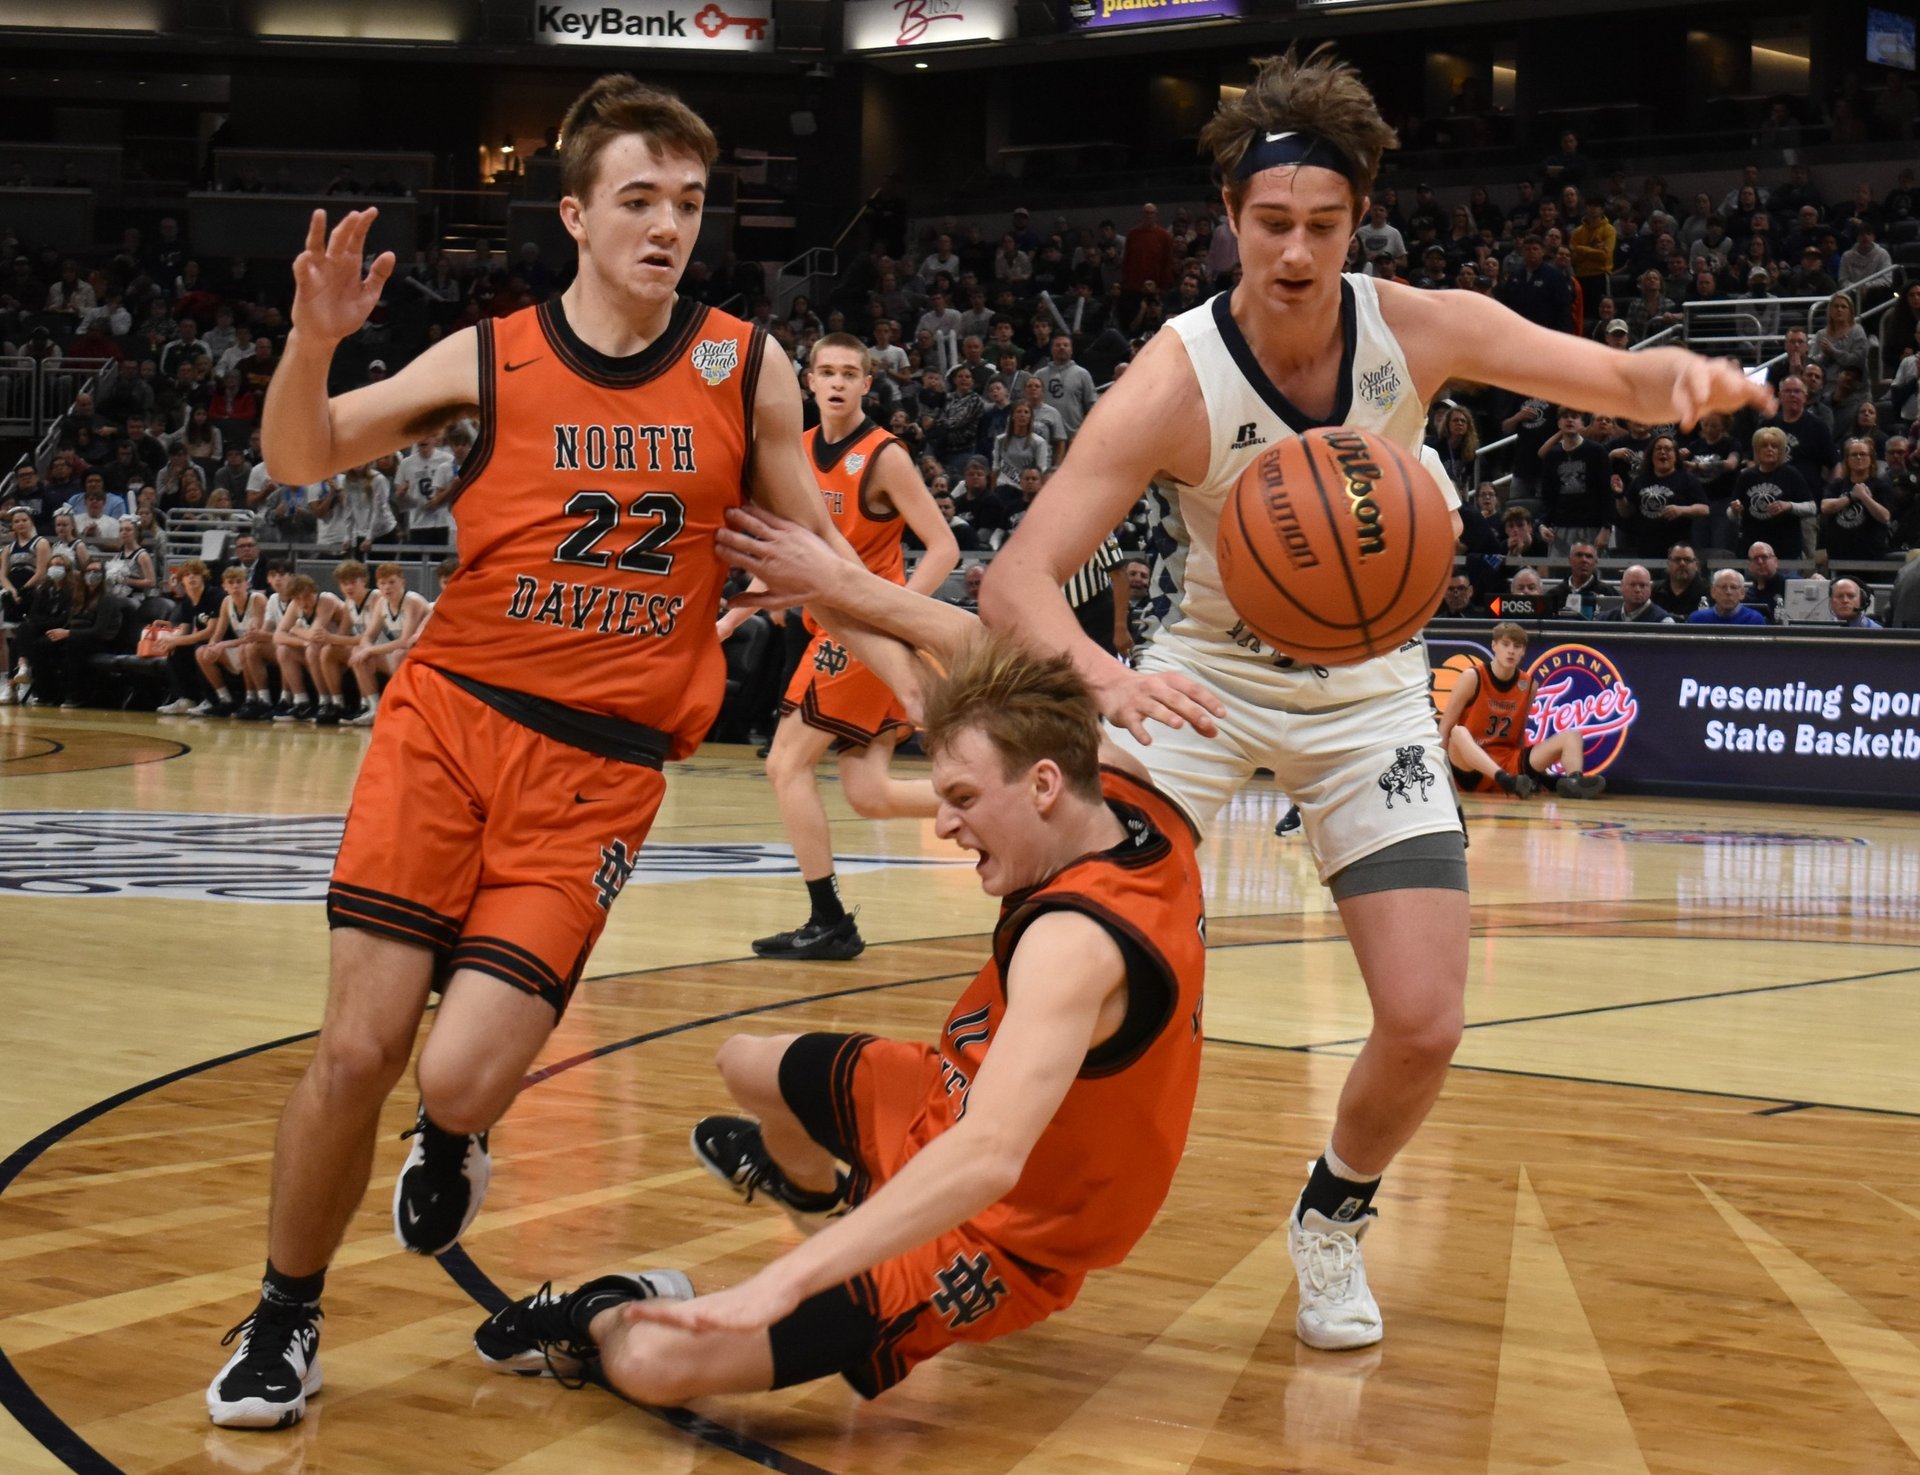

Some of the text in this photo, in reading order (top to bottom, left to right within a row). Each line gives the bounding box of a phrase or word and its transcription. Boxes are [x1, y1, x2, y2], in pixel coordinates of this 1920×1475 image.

[538, 5, 687, 39] KeyBank
[693, 352, 736, 370] Finals
[694, 341, 736, 357] State
[1360, 361, 1393, 390] State
[1361, 373, 1401, 401] Finals
[554, 424, 697, 472] NORTH
[552, 491, 685, 575] 22
[506, 574, 684, 640] DAVIESS
[1501, 600, 1535, 612] POSS.
[1538, 653, 1613, 685] NDIANA
[1524, 676, 1638, 746] Fever
[1679, 678, 1844, 719] Presenting
[1486, 715, 1512, 737] 32
[1704, 720, 1786, 752] State
